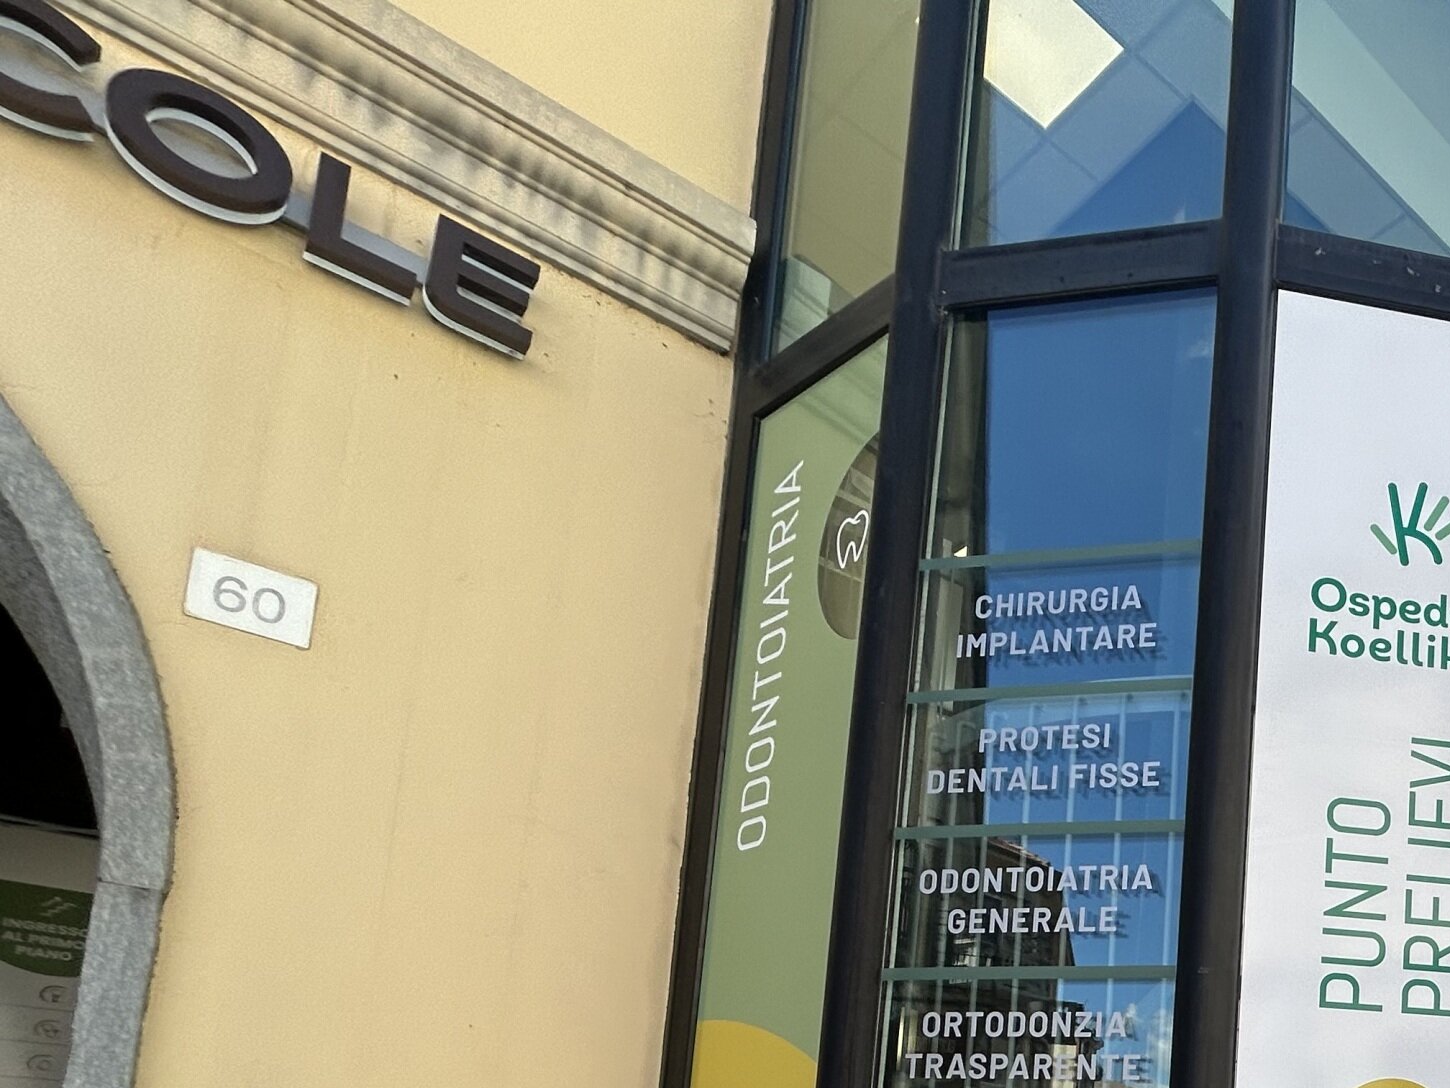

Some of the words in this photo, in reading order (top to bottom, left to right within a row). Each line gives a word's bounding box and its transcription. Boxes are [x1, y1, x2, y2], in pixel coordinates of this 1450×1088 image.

[213, 576, 285, 624] 60
[975, 585, 1142, 619] CHIRURGIA
[736, 459, 805, 851] ODONTOIATRIA
[956, 622, 1158, 658] IMPLANTARE
[978, 722, 1111, 753] PROTESI
[926, 763, 1059, 795] DENTALI
[1069, 761, 1161, 789] FISSE
[918, 864, 1154, 895] ODONTOIATRIA
[947, 906, 1118, 935] GENERALE
[1318, 796, 1392, 1013] PUNTO
[922, 1011, 1128, 1038] ORTODONZIA
[904, 1053, 1142, 1081] TRASPARENTE
